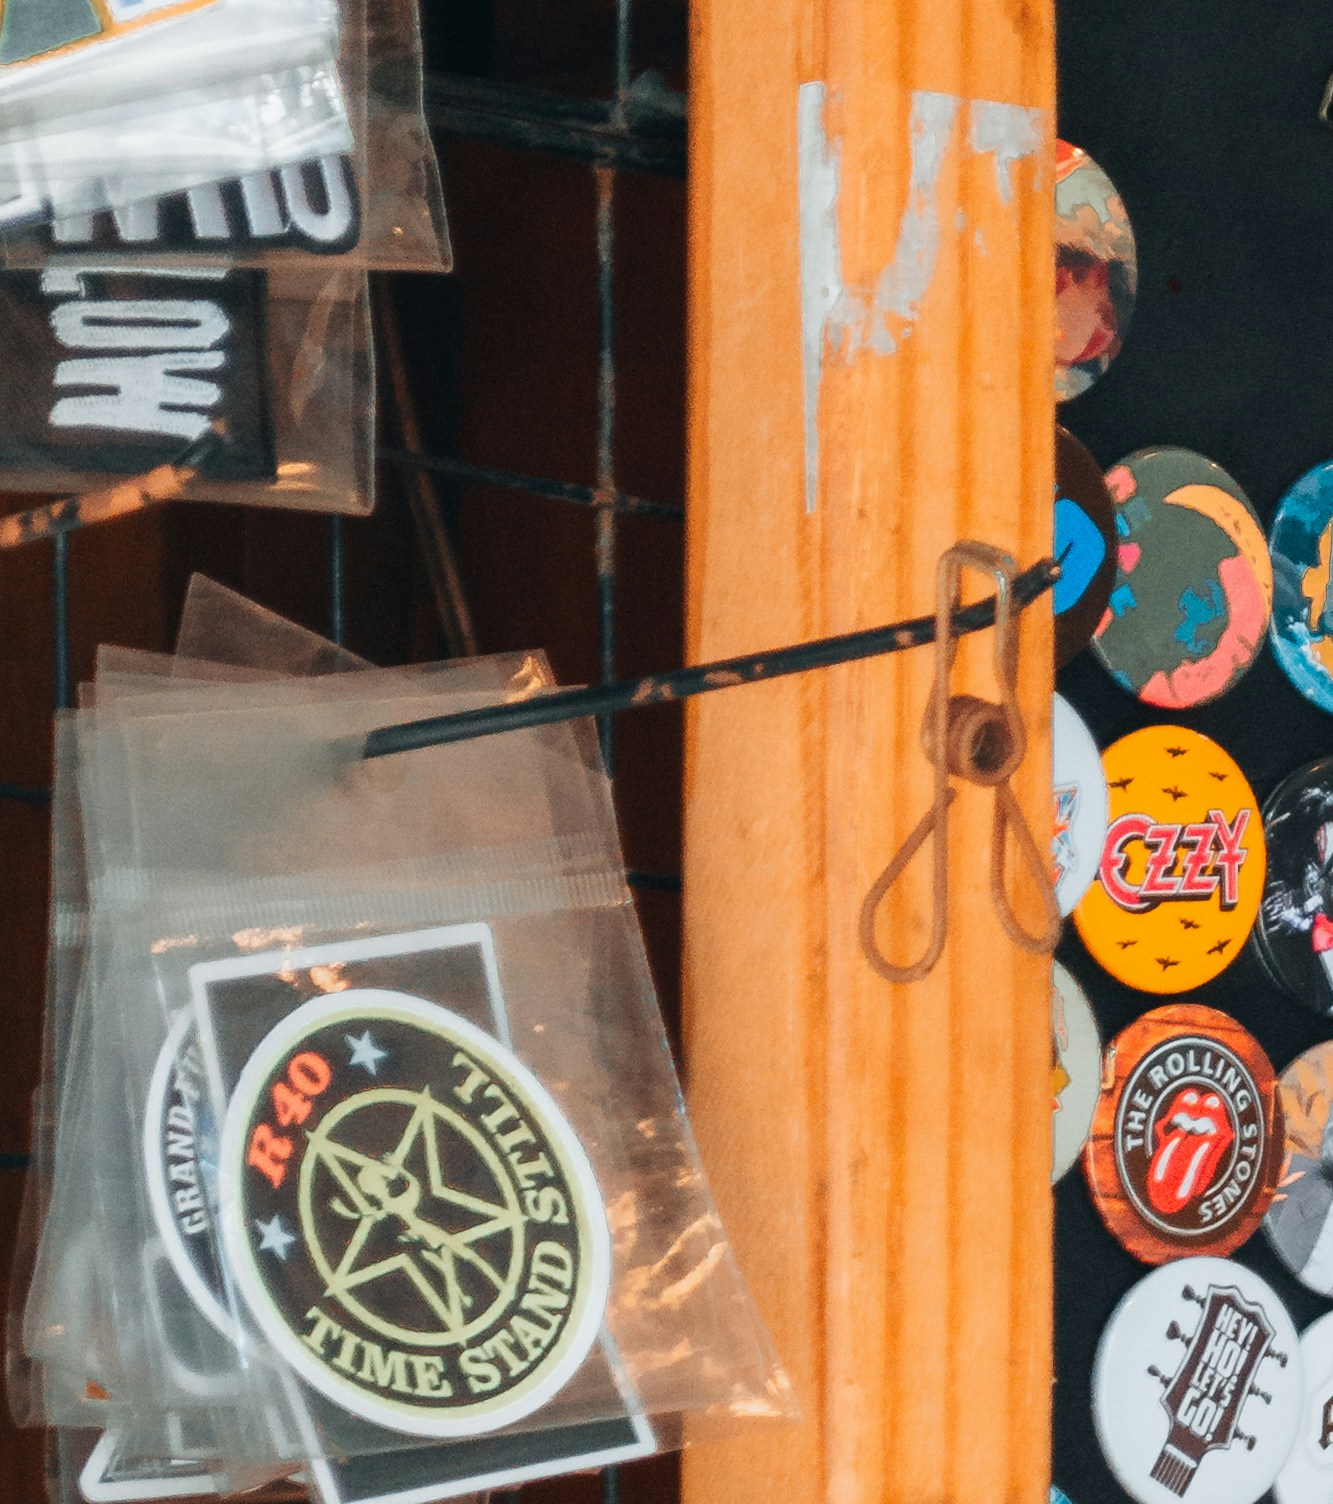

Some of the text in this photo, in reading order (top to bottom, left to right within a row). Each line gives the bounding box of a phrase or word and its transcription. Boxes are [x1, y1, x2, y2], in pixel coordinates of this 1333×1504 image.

[1100, 809, 1251, 910] OZZY
[164, 1104, 210, 1235] GRAND
[1126, 1049, 1259, 1223] THE ROLLING STONES
[303, 1051, 573, 1399] TIME STAND STILL
[1202, 1327, 1252, 1379] HO!
[1214, 1303, 1259, 1351] HEY!
[1176, 1384, 1224, 1445] GO!
[1190, 1356, 1241, 1408] LET'S
